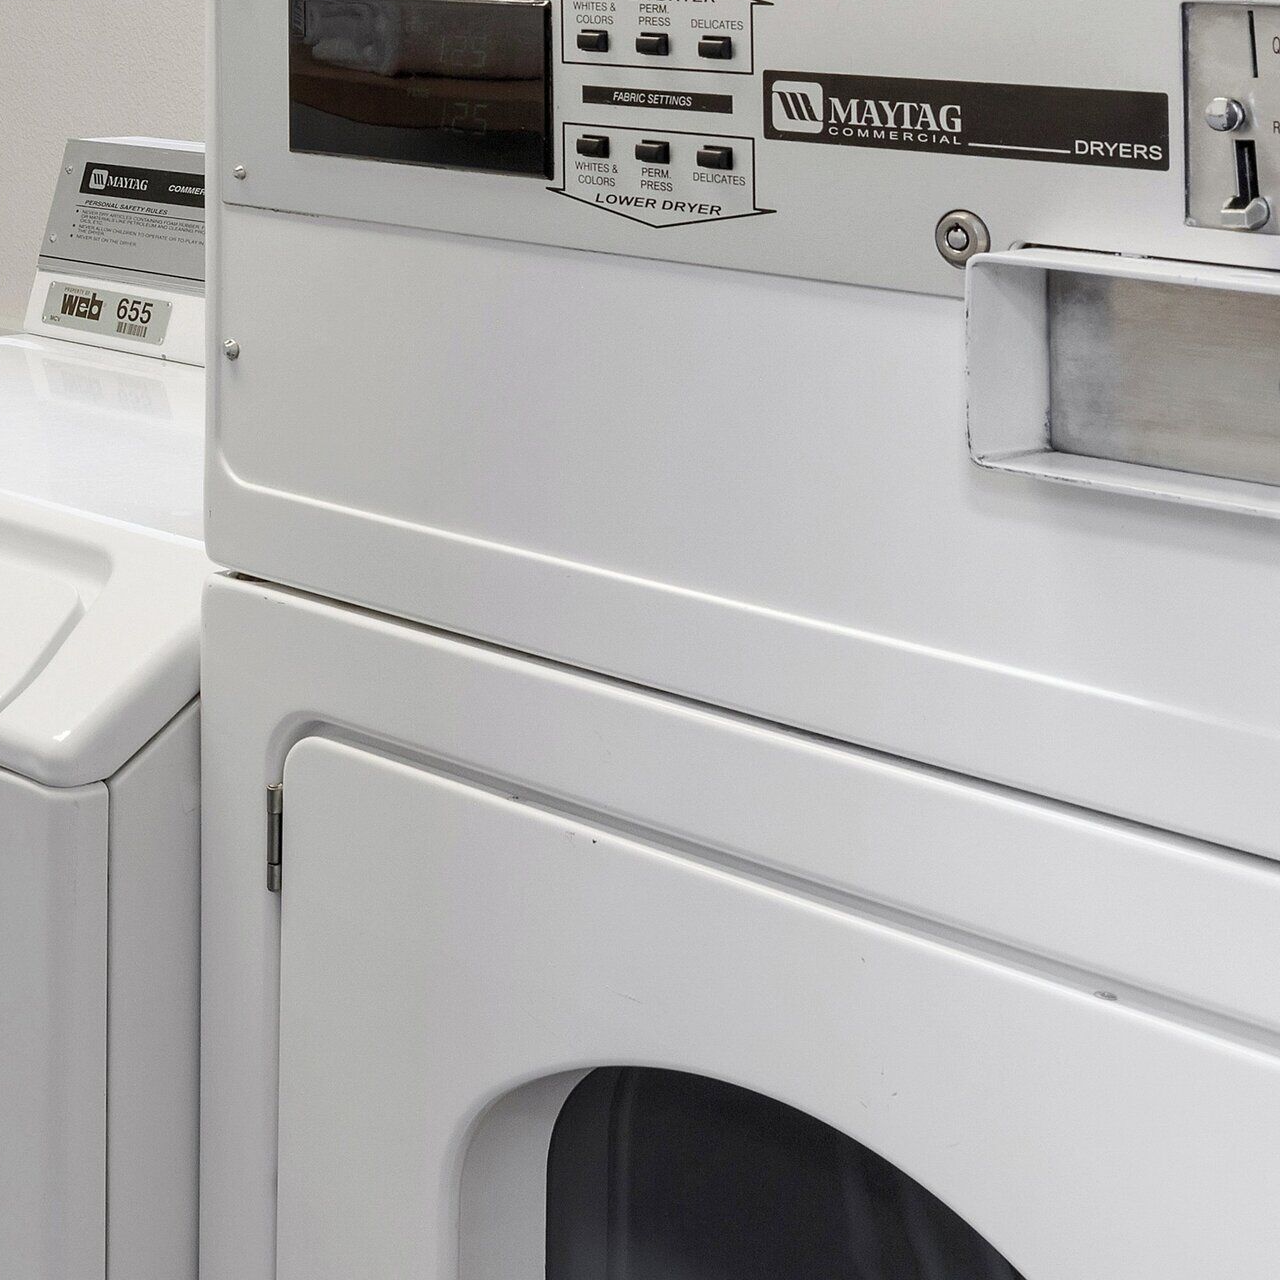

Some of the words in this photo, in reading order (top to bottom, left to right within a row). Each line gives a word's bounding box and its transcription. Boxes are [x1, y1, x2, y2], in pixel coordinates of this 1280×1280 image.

[573, 1, 608, 12] WHITES
[610, 3, 616, 12] &
[639, 3, 669, 14] PERM.
[576, 15, 614, 25] COLORS
[638, 16, 671, 27] PRESS
[690, 19, 744, 30] DELICATES
[613, 91, 646, 104] FABRIC
[647, 93, 693, 107] SETTINGS
[828, 96, 963, 133] MAYTAG
[828, 126, 963, 146] COMMERCIAL
[1074, 138, 1163, 161] DRYERS
[575, 161, 609, 173] WHITES
[612, 164, 618, 174] &
[641, 167, 672, 178] PERM.
[106, 176, 149, 191] MAYTAG
[578, 175, 616, 187] COLORS
[693, 172, 746, 186] DELICATES
[640, 180, 673, 192] PRESS
[85, 200, 118, 209] PERSONAL
[119, 204, 146, 212] SAFETY
[145, 207, 169, 215] RULES
[595, 193, 656, 209] LOWER
[662, 200, 722, 215] DRYER
[116, 298, 154, 324] 655
